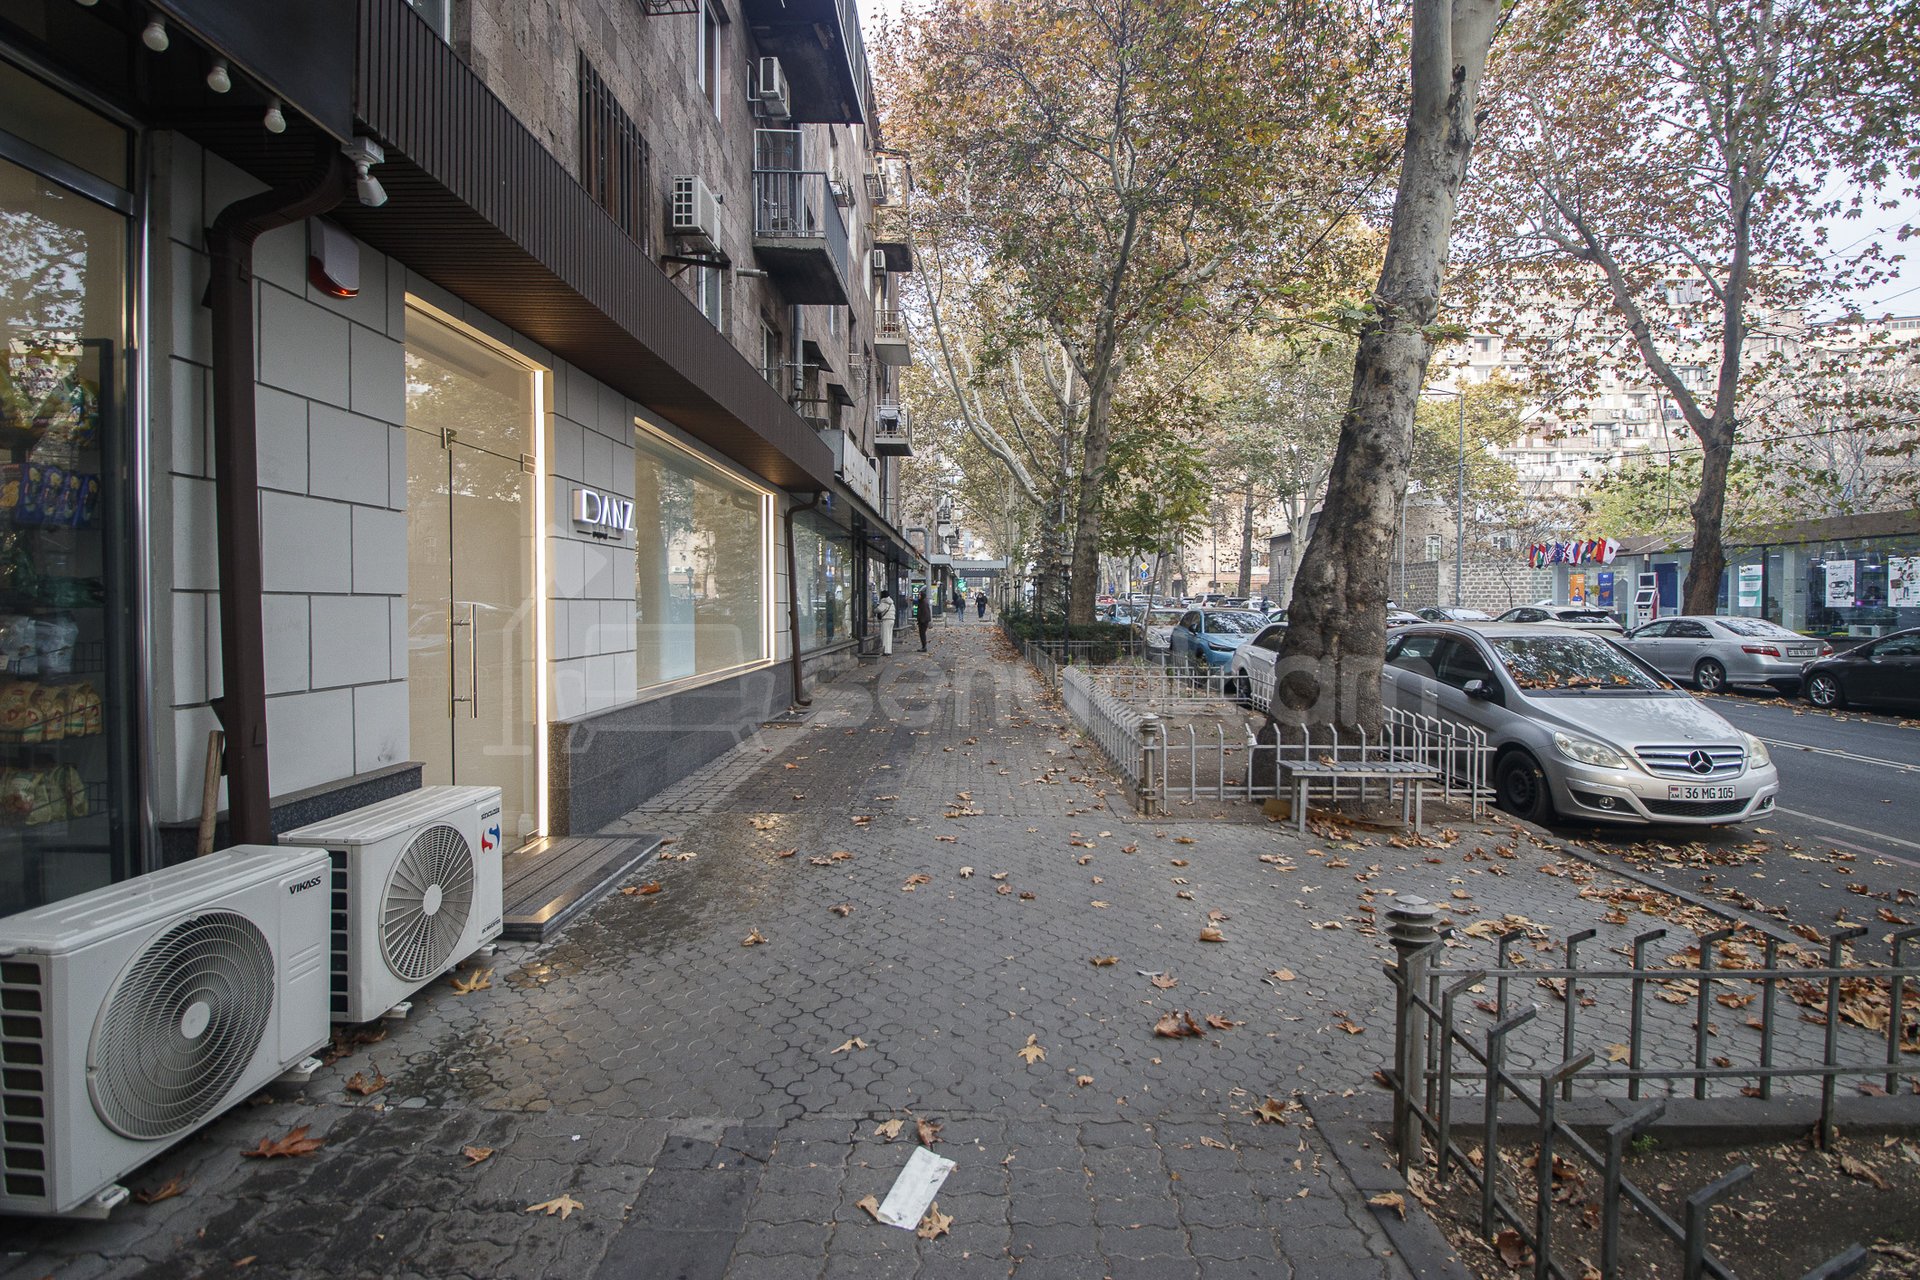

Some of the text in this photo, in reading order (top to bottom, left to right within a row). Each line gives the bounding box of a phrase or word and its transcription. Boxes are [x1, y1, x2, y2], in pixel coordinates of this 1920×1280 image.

[581, 489, 634, 531] DANZ
[1685, 787, 1699, 799] 36
[1701, 787, 1716, 799] MG
[1717, 787, 1733, 799] 105
[289, 876, 321, 895] VIKASS
